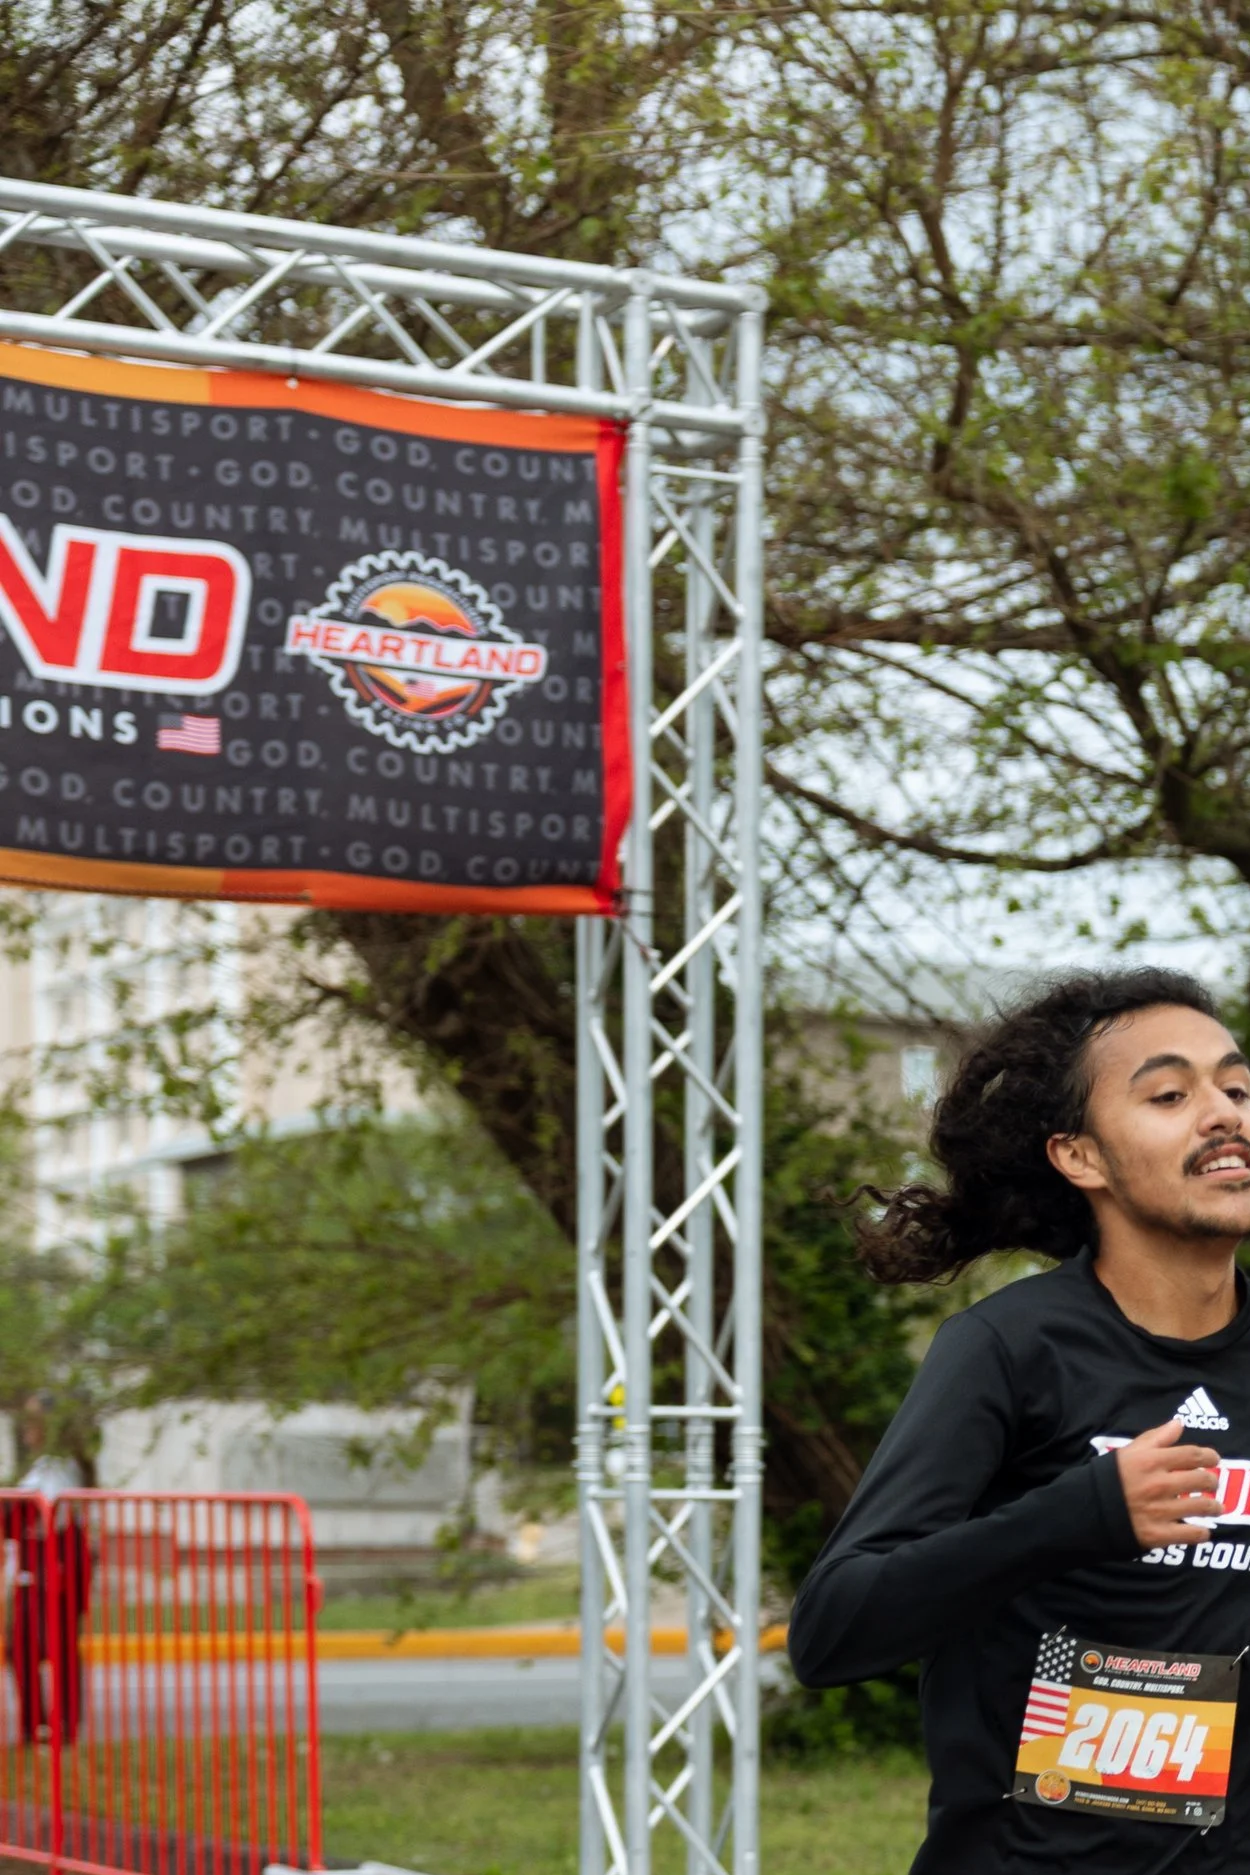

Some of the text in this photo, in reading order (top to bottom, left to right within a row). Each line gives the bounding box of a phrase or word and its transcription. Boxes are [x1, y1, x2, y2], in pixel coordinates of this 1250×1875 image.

[3, 385, 294, 442] MULTISPORT
[10, 479, 84, 518] OD.
[102, 494, 321, 538] COUNTRY.
[339, 515, 600, 569] MULTISPOR
[336, 471, 547, 525] COUNTRY.
[490, 581, 601, 612] OUNT
[291, 621, 542, 676] HEARTLAND
[494, 717, 603, 750] OUNT
[16, 814, 306, 864] MULTISPORT
[346, 793, 604, 842] MULTISPOR
[1104, 1655, 1202, 1677] HEARTLAND
[1058, 1703, 1210, 1782] 2064
